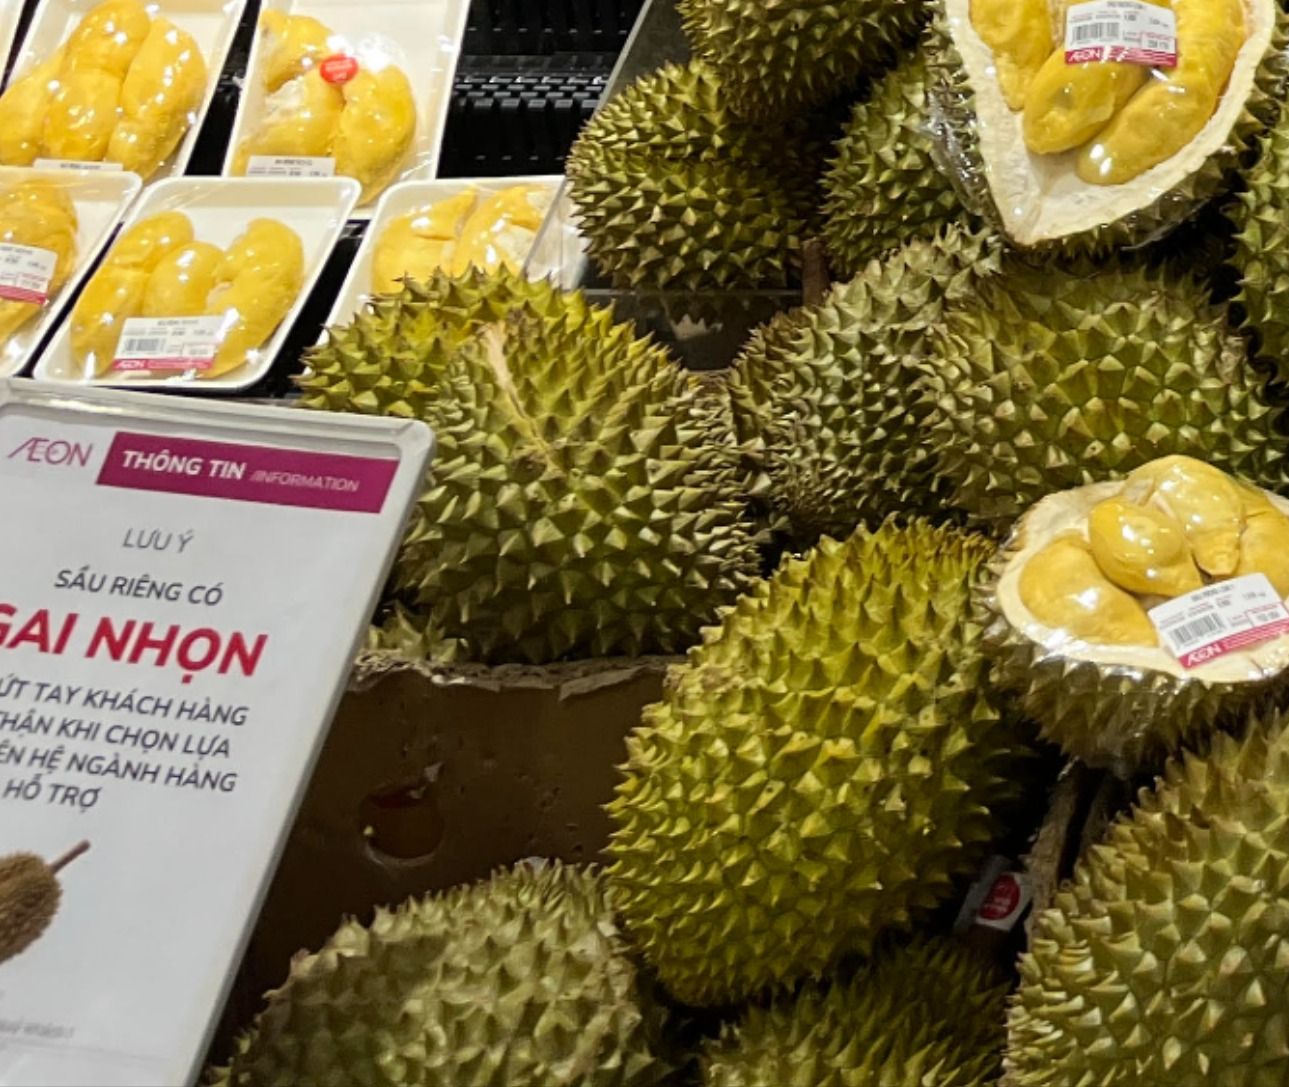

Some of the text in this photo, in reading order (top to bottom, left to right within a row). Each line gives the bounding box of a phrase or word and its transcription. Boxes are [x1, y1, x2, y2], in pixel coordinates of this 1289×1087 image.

[121, 448, 202, 476] THÔNG
[209, 459, 247, 480] TIN
[123, 527, 195, 553] LƯU Ý
[108, 574, 182, 602] RIÊNG
[187, 581, 224, 607] CÓ
[84, 616, 268, 684] NHỌN
[0, 673, 249, 727] ỨT TAY KHÁCH HÀNG
[0, 709, 230, 761] HẬN KHI CHỌN LỰA
[28, 745, 65, 774] HỆ
[67, 752, 161, 785] NGÀNH
[164, 763, 238, 793] HÀNG
[3, 772, 102, 814] HỖ TRỢ
